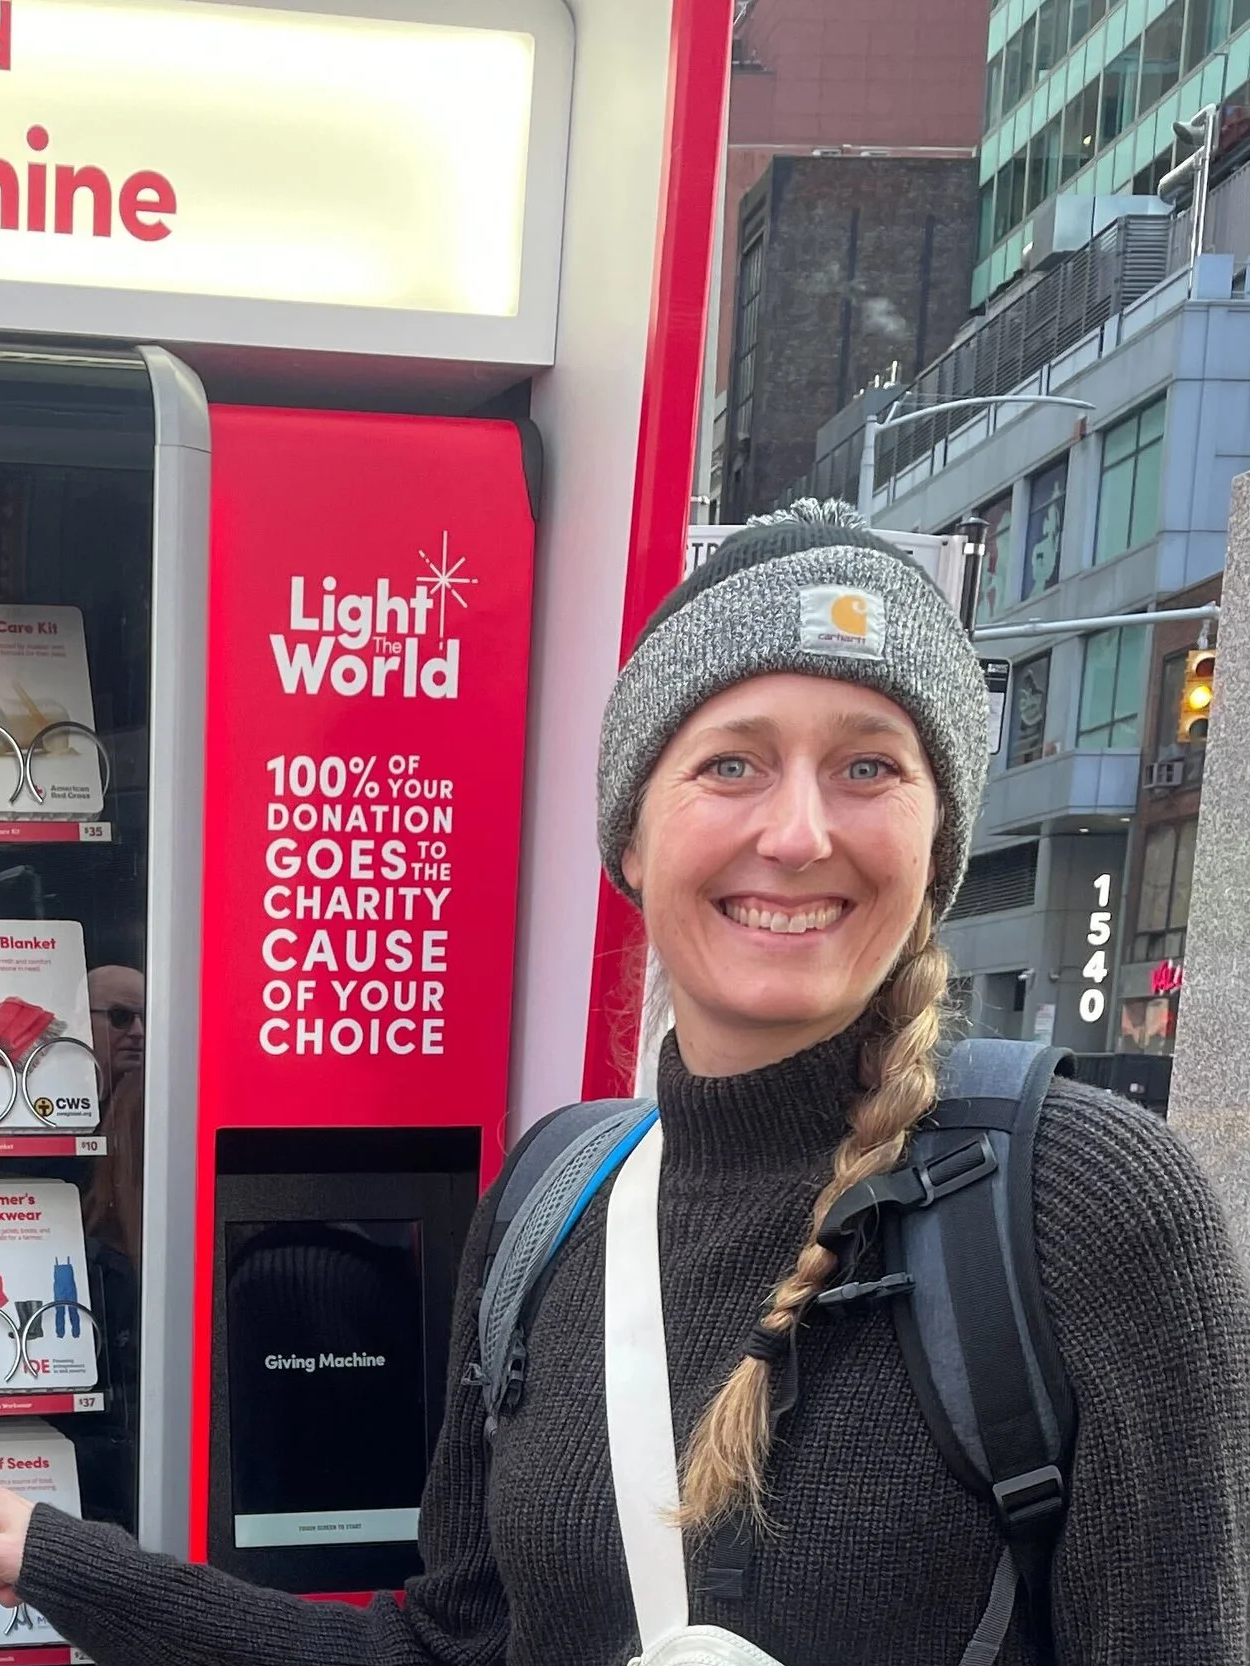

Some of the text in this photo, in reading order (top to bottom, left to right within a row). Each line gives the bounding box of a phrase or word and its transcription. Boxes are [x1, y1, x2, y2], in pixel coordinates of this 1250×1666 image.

[38, 620, 59, 635] Kit
[290, 575, 434, 652] Light
[372, 636, 403, 655] The
[818, 632, 866, 646] carhartt
[269, 634, 461, 699] World
[266, 755, 453, 799] 100% OF YOUR
[266, 802, 453, 834] DONATION
[265, 839, 451, 881] GOES TO THE
[264, 886, 451, 921] CHARITY
[0, 936, 56, 950] Blanket
[262, 929, 448, 973] CAUSE
[1079, 873, 1112, 1023] 1540
[262, 979, 444, 1012] OF YOUR
[259, 1017, 444, 1056] CHOICE
[56, 1097, 91, 1110] CWS
[81, 1140, 98, 1151] $10
[265, 1352, 386, 1373] Giving Machine
[7, 1457, 50, 1470] Seeds
